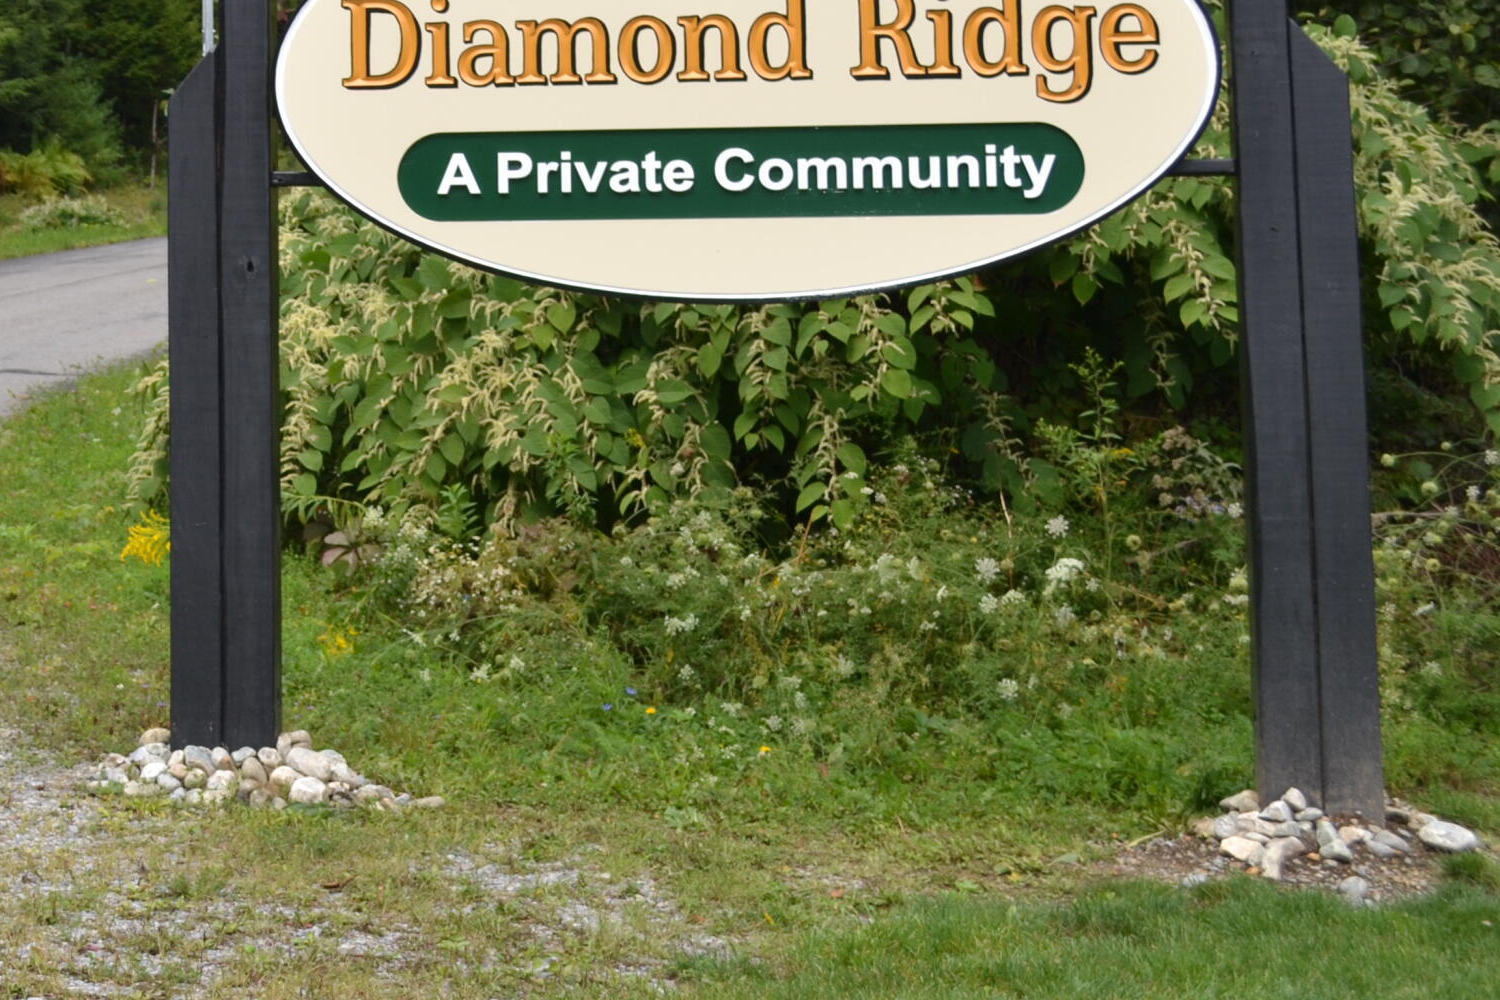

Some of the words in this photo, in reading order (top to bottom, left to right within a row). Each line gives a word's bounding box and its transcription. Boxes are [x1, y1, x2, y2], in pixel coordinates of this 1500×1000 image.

[437, 152, 481, 196] A
[496, 148, 696, 195] Private
[713, 142, 1057, 199] Community
